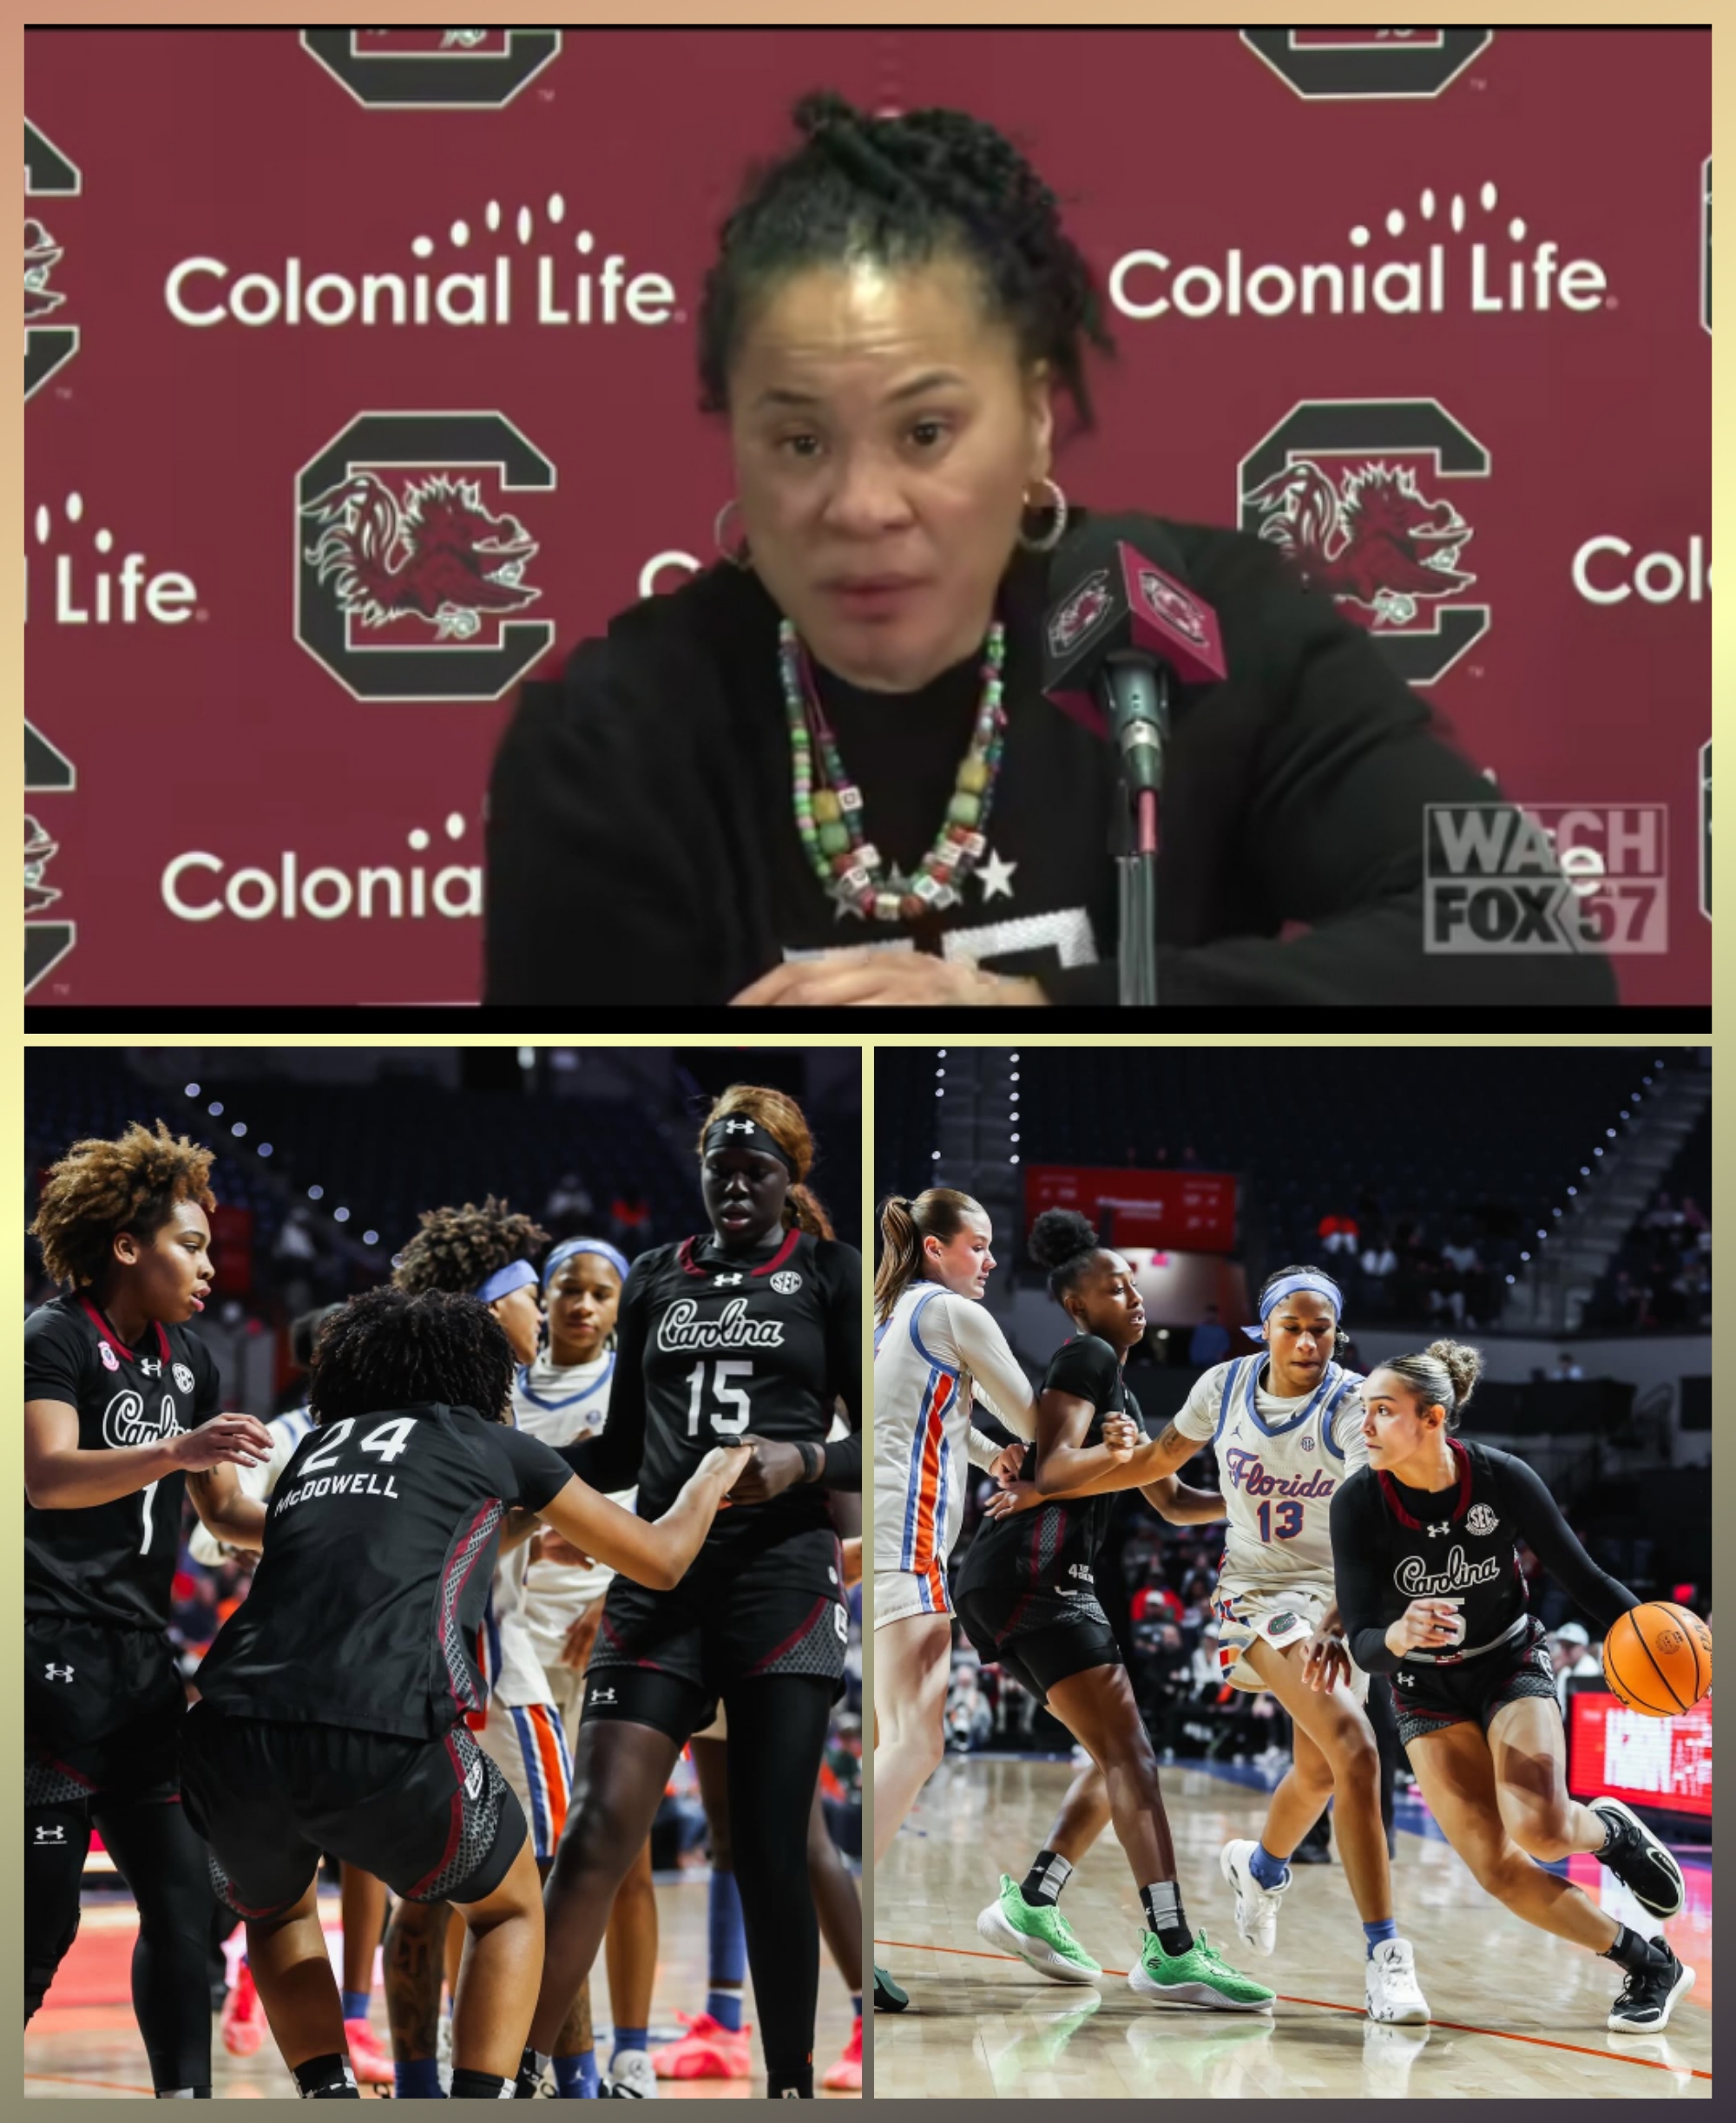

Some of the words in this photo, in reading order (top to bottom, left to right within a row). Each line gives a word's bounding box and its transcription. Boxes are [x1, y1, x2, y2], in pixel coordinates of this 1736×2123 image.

[165, 235, 510, 326] Colonial
[538, 230, 675, 325] Life
[1108, 225, 1444, 319] Colonial
[1471, 217, 1607, 312] Life
[56, 528, 197, 624] Life
[1571, 535, 1712, 605] Col
[161, 828, 483, 922] Colonia
[771, 1272, 802, 1294] SEC
[657, 1298, 785, 1351] Carolina
[686, 1360, 753, 1436] 15
[297, 1417, 418, 1477] 24
[1226, 1448, 1336, 1499] Florida
[1257, 1500, 1305, 1543] 13
[1470, 1504, 1494, 1530] SEC
[1393, 1544, 1501, 1597] Carolina
